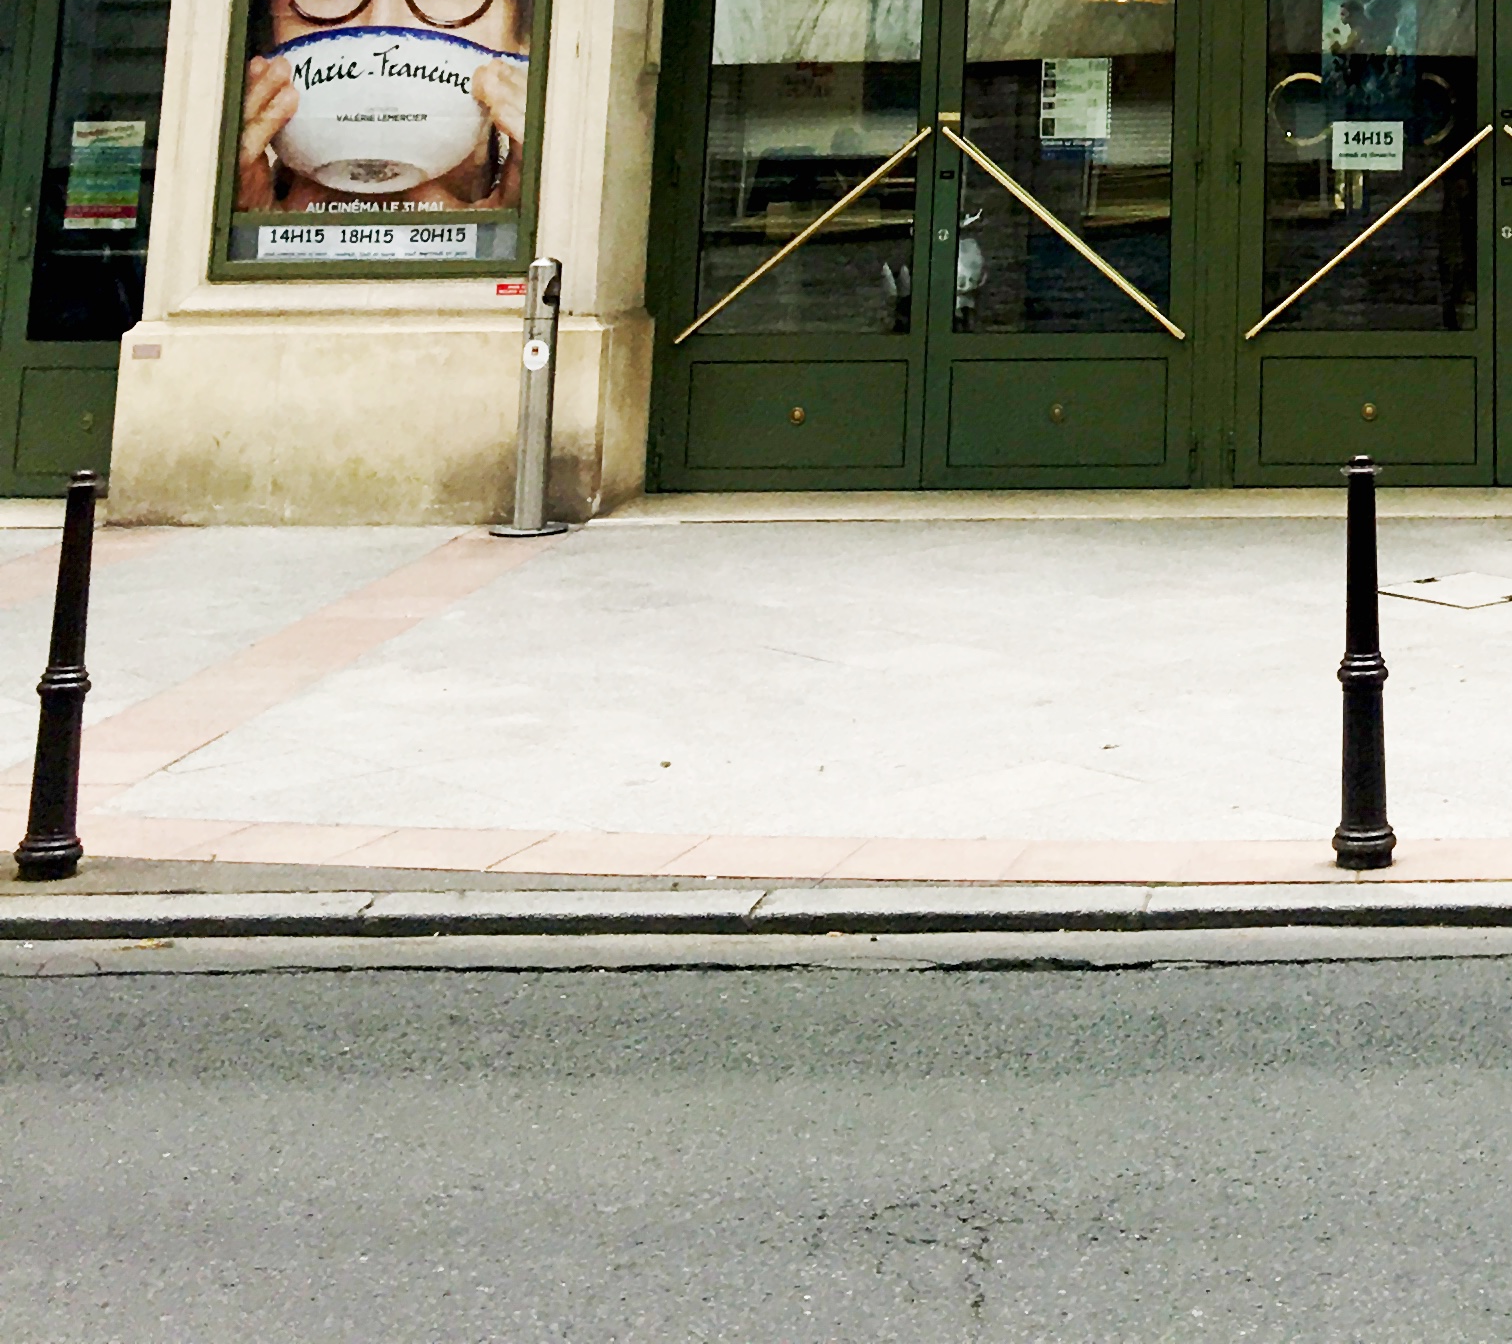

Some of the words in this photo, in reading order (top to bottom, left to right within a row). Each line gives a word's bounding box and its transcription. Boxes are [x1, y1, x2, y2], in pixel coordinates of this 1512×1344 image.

[1343, 130, 1394, 146] 14H15
[305, 201, 326, 214] AU
[328, 199, 380, 214] CINÉMA
[417, 201, 444, 212] MAI
[270, 229, 325, 244] 14H15
[341, 229, 394, 244] 18H15
[410, 227, 466, 243] 20H15
